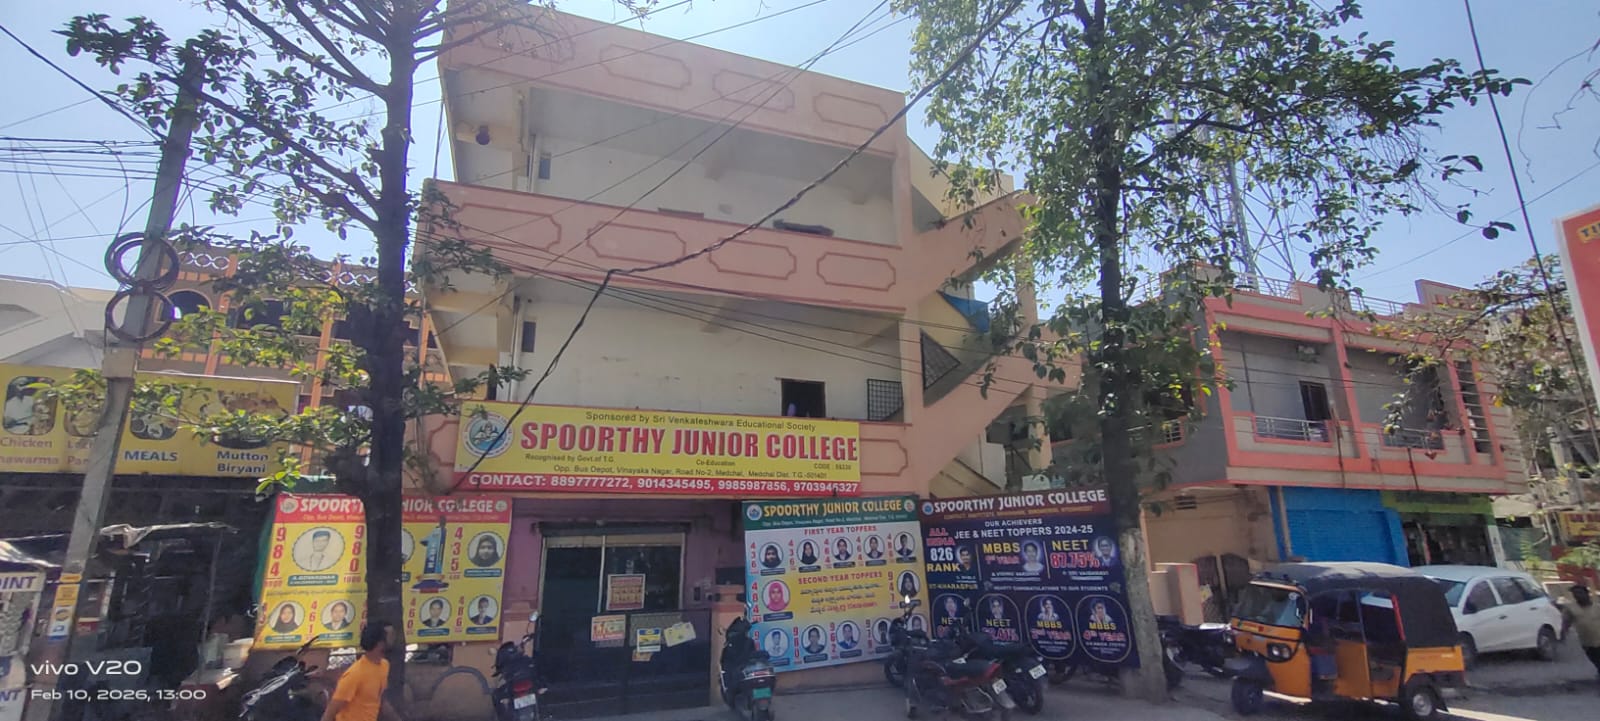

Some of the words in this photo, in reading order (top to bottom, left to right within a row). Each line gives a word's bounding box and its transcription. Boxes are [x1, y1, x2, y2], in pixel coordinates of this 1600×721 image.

[585, 411, 637, 422] Sponsored
[639, 413, 650, 424] by
[653, 414, 665, 423] Sri
[668, 415, 734, 427] Venkateshwara
[736, 419, 785, 429] Educational
[787, 421, 816, 432] Society
[0, 437, 53, 448] Chicken
[520, 421, 665, 454] SPOORTHY
[672, 428, 759, 458] JUNIOR
[766, 434, 858, 462] COLLEGE
[124, 450, 178, 462] MEALS
[216, 450, 269, 462] Mutton
[216, 463, 266, 474] Biryani
[574, 465, 588, 473] Bus
[469, 474, 546, 487] CONTACT:
[551, 475, 633, 489] 8897777272,
[637, 478, 715, 491] 9014345495,
[718, 480, 791, 493] 9985987856,
[934, 498, 994, 513] SPOORTHY
[998, 494, 1045, 510] JUNIOR
[1048, 489, 1107, 504] COLLEGE
[764, 503, 820, 518] SPOORTHY
[823, 501, 859, 517] JUNIOR
[862, 500, 902, 512] COLLEGE
[1001, 518, 1043, 526] ACHIEVERS
[954, 529, 971, 539] JEE
[972, 530, 979, 538] &
[981, 528, 1004, 538] NEET
[1006, 526, 1052, 537] TOPPERS
[1054, 524, 1094, 535] 2024-25
[982, 542, 1021, 554] MBBS
[1051, 539, 1089, 551] NEET
[930, 547, 954, 561] 826
[927, 563, 961, 572] RANK
[798, 576, 829, 585] SECOND
[831, 574, 849, 582] YEAR
[852, 571, 882, 580] TOPPERS
[985, 618, 1012, 627] NEET
[1037, 620, 1063, 629] MBBS
[1088, 622, 1117, 631] MBBS
